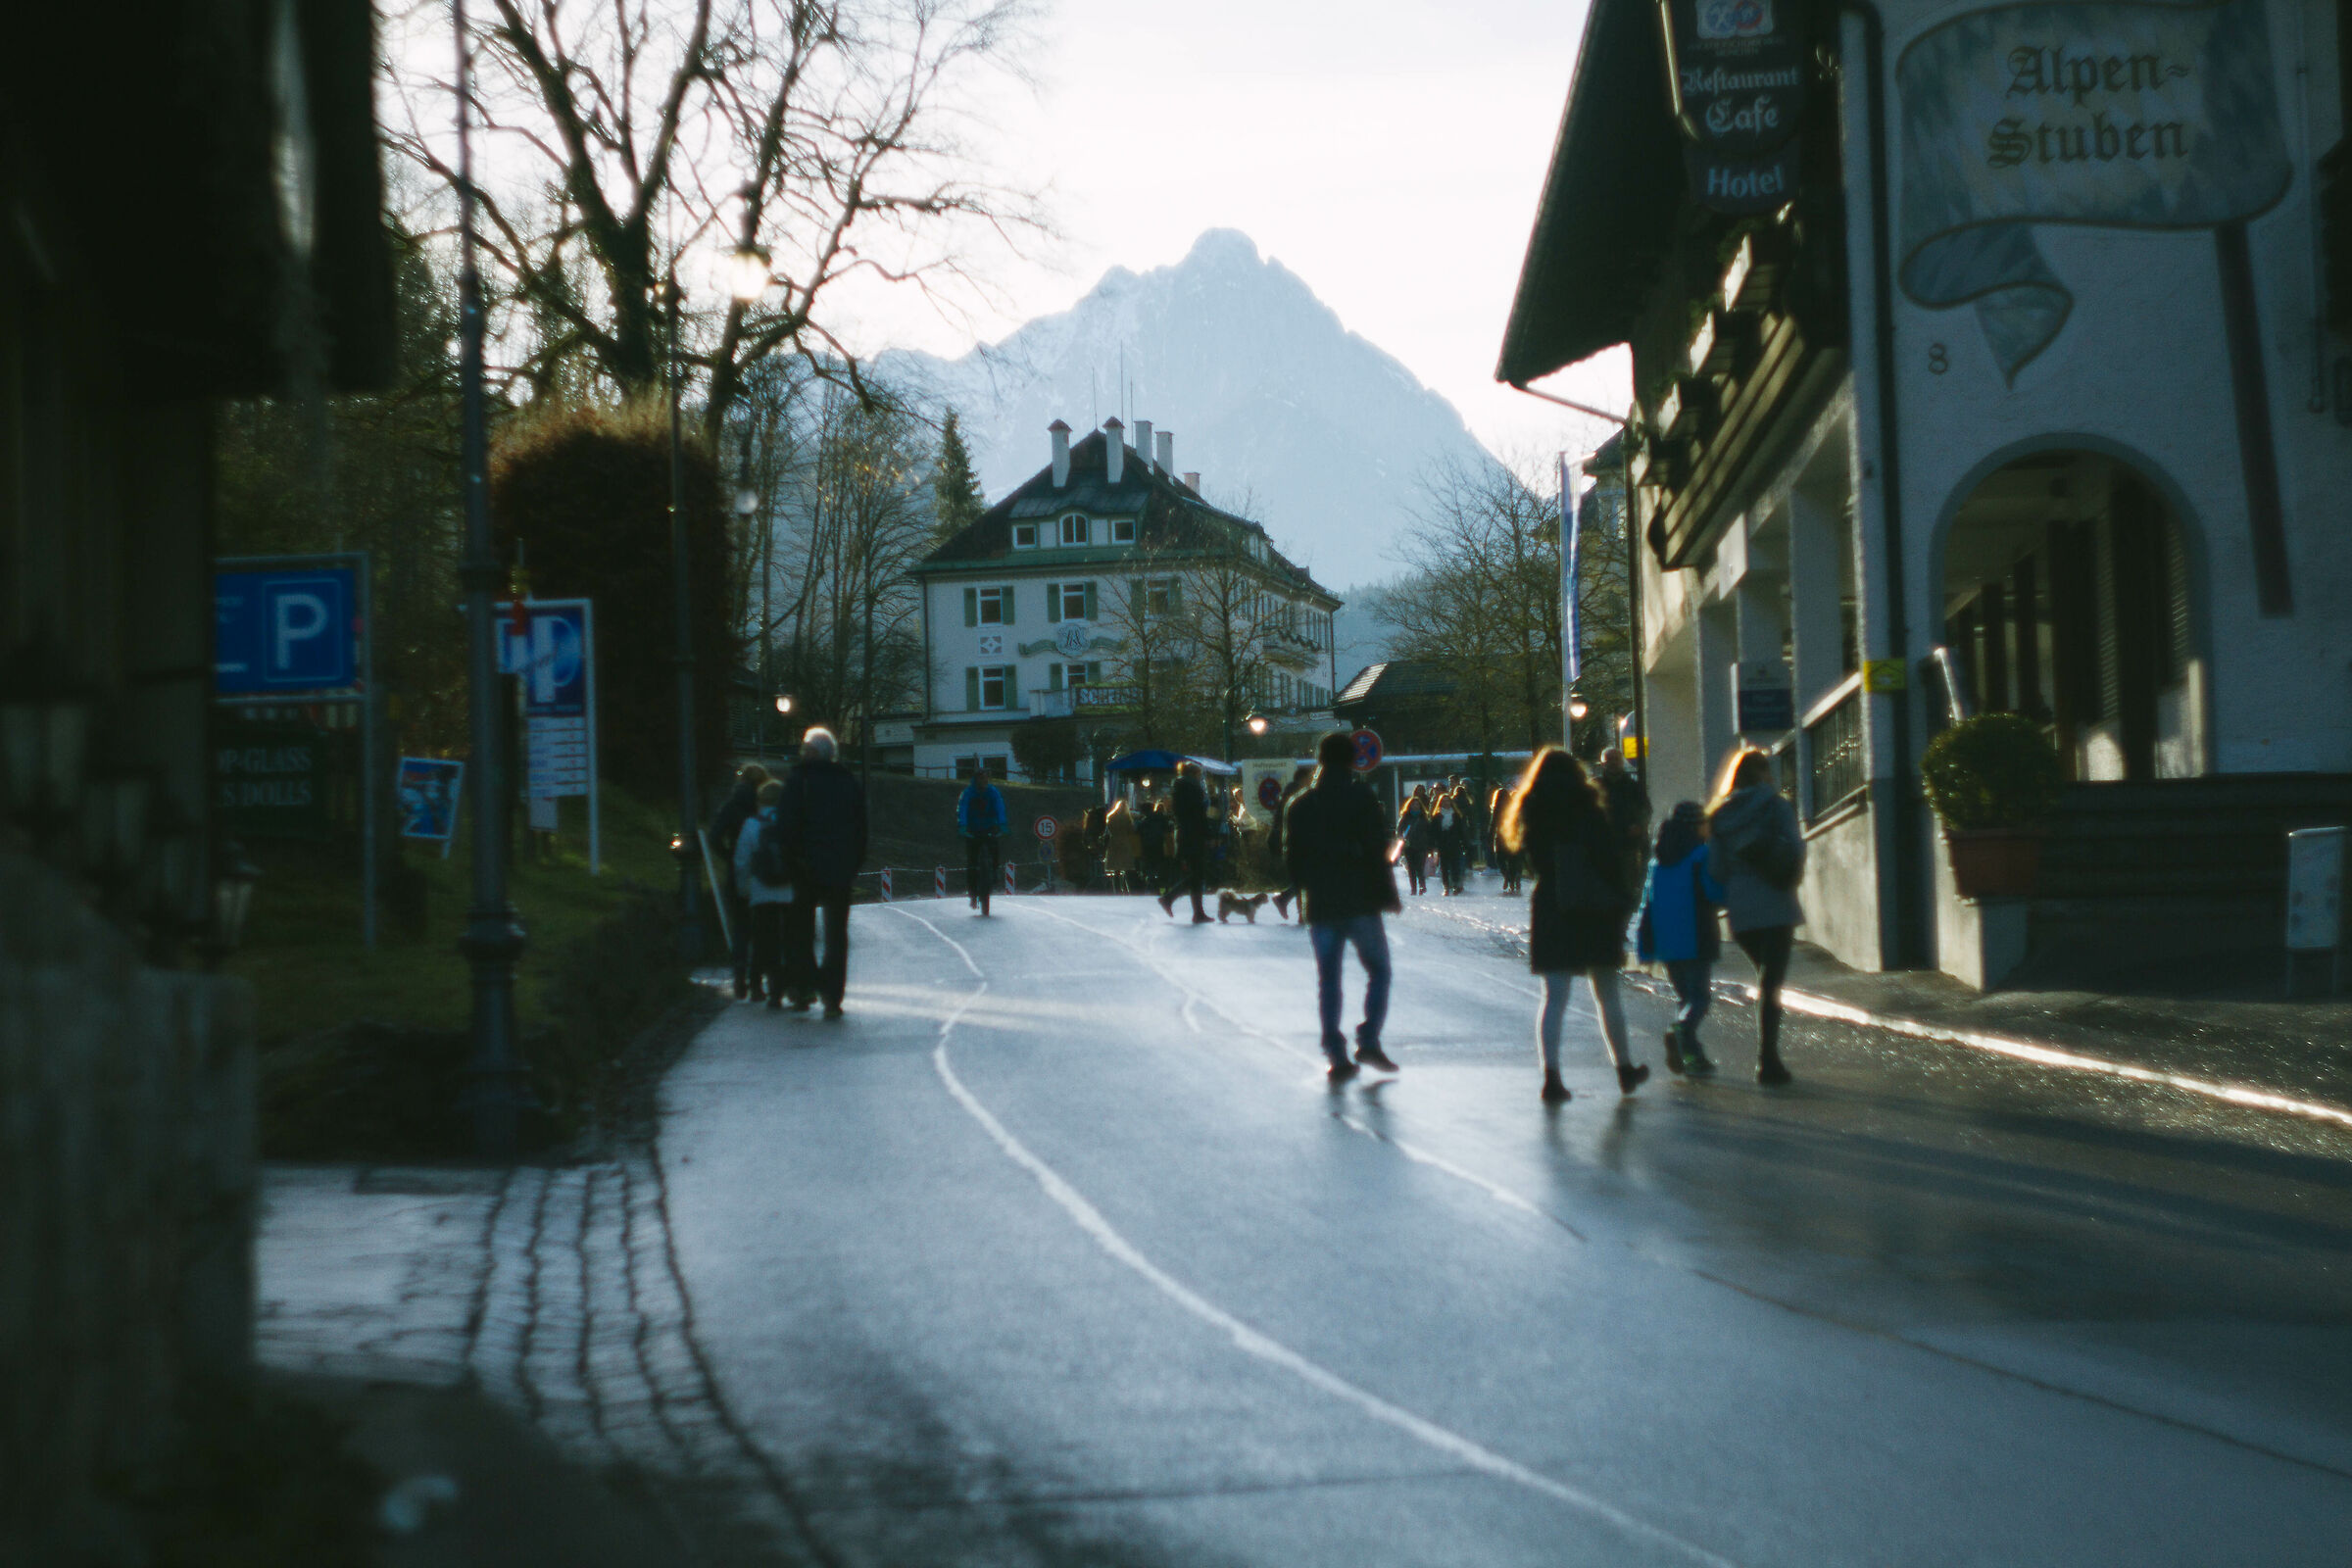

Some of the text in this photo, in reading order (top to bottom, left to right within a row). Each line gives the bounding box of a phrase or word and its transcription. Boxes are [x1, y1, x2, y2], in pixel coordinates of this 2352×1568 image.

[1986, 110, 2189, 170] Stuben
[1706, 164, 1786, 198] Hotel
[1928, 342, 1949, 376] 8
[276, 593, 329, 670] P
[1041, 822, 1053, 833] 15
